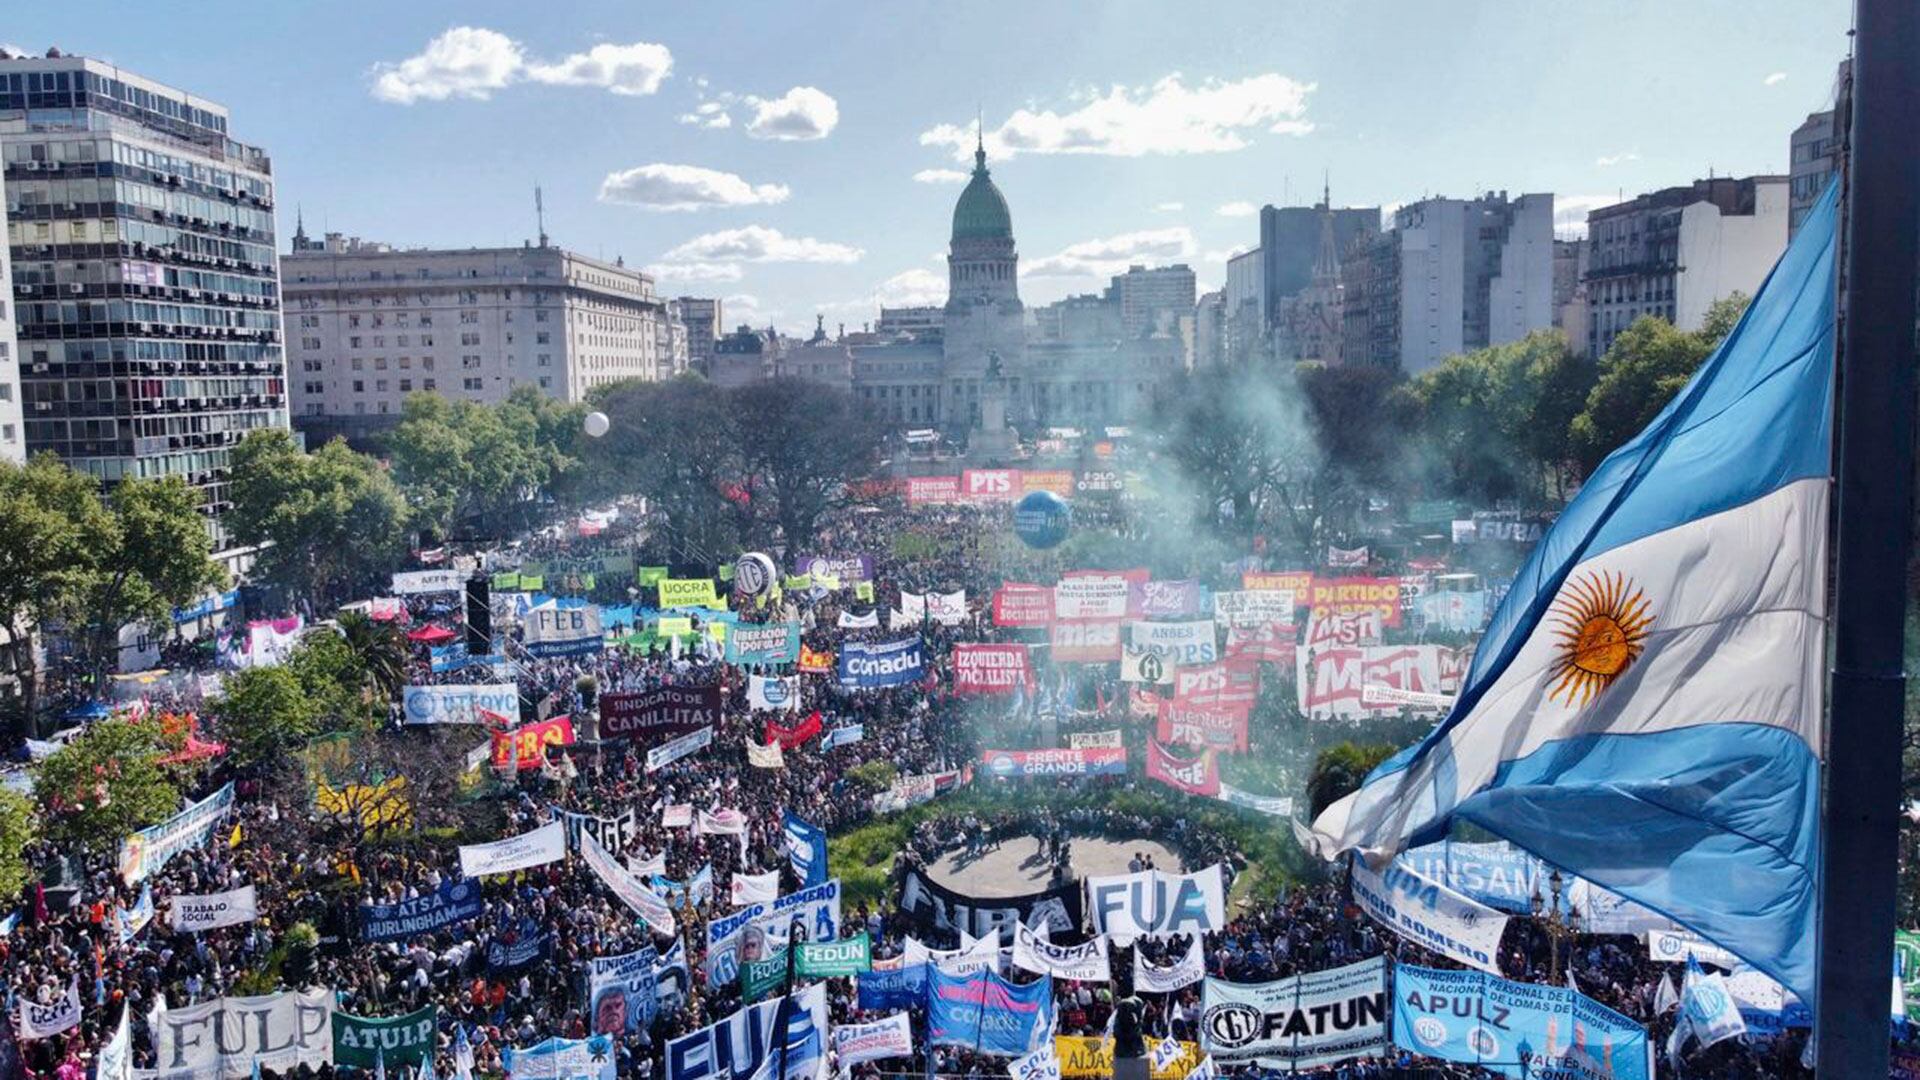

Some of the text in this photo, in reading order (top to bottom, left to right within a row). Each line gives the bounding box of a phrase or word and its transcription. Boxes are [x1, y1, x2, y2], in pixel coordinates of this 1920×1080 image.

[970, 473, 1011, 492] PTS
[664, 582, 711, 594] UOCRA
[1245, 575, 1311, 589] PARTIDO
[1315, 584, 1399, 602] PARTIDO
[540, 610, 585, 631] FEB
[732, 628, 788, 645] LIBERACIÓN
[957, 650, 1024, 668] IZQUIERDA
[1180, 667, 1227, 695] PTS
[614, 691, 702, 711] SINDICATO DE
[606, 706, 714, 732] CANILLITAS
[1026, 751, 1083, 763] FRENTE
[1023, 762, 1087, 774] GRANDE
[1408, 858, 1540, 898] UNSAM
[401, 894, 443, 917] ATSA
[773, 882, 836, 910] ROMERO
[1095, 878, 1212, 933] FUA
[182, 902, 227, 913] TRABAJO
[182, 912, 216, 922] SOCIAL
[367, 905, 459, 938] HURLINGHAM
[710, 904, 764, 943] SERGIO
[1401, 914, 1489, 964] ROMERO
[804, 943, 865, 961] FEDUN
[597, 955, 636, 975] UNION
[614, 957, 653, 976] ARGEN
[1400, 966, 1466, 983] ASOCIACIÓN
[1468, 973, 1487, 985] DEL
[1489, 978, 1545, 1000] PERSONAL
[1550, 989, 1564, 1002] DE
[1261, 992, 1385, 1040] FATUN
[1406, 990, 1511, 1032] APULZ
[1428, 983, 1611, 1034] NACIONAL DE LOMAS DE ZAMORA
[340, 1019, 433, 1050] ATULP
[1213, 1008, 1251, 1041] CGT
[169, 1004, 327, 1068] FULP
[1316, 1035, 1385, 1055] ORGANIZADOS
[1520, 1049, 1579, 1069] WALTER
